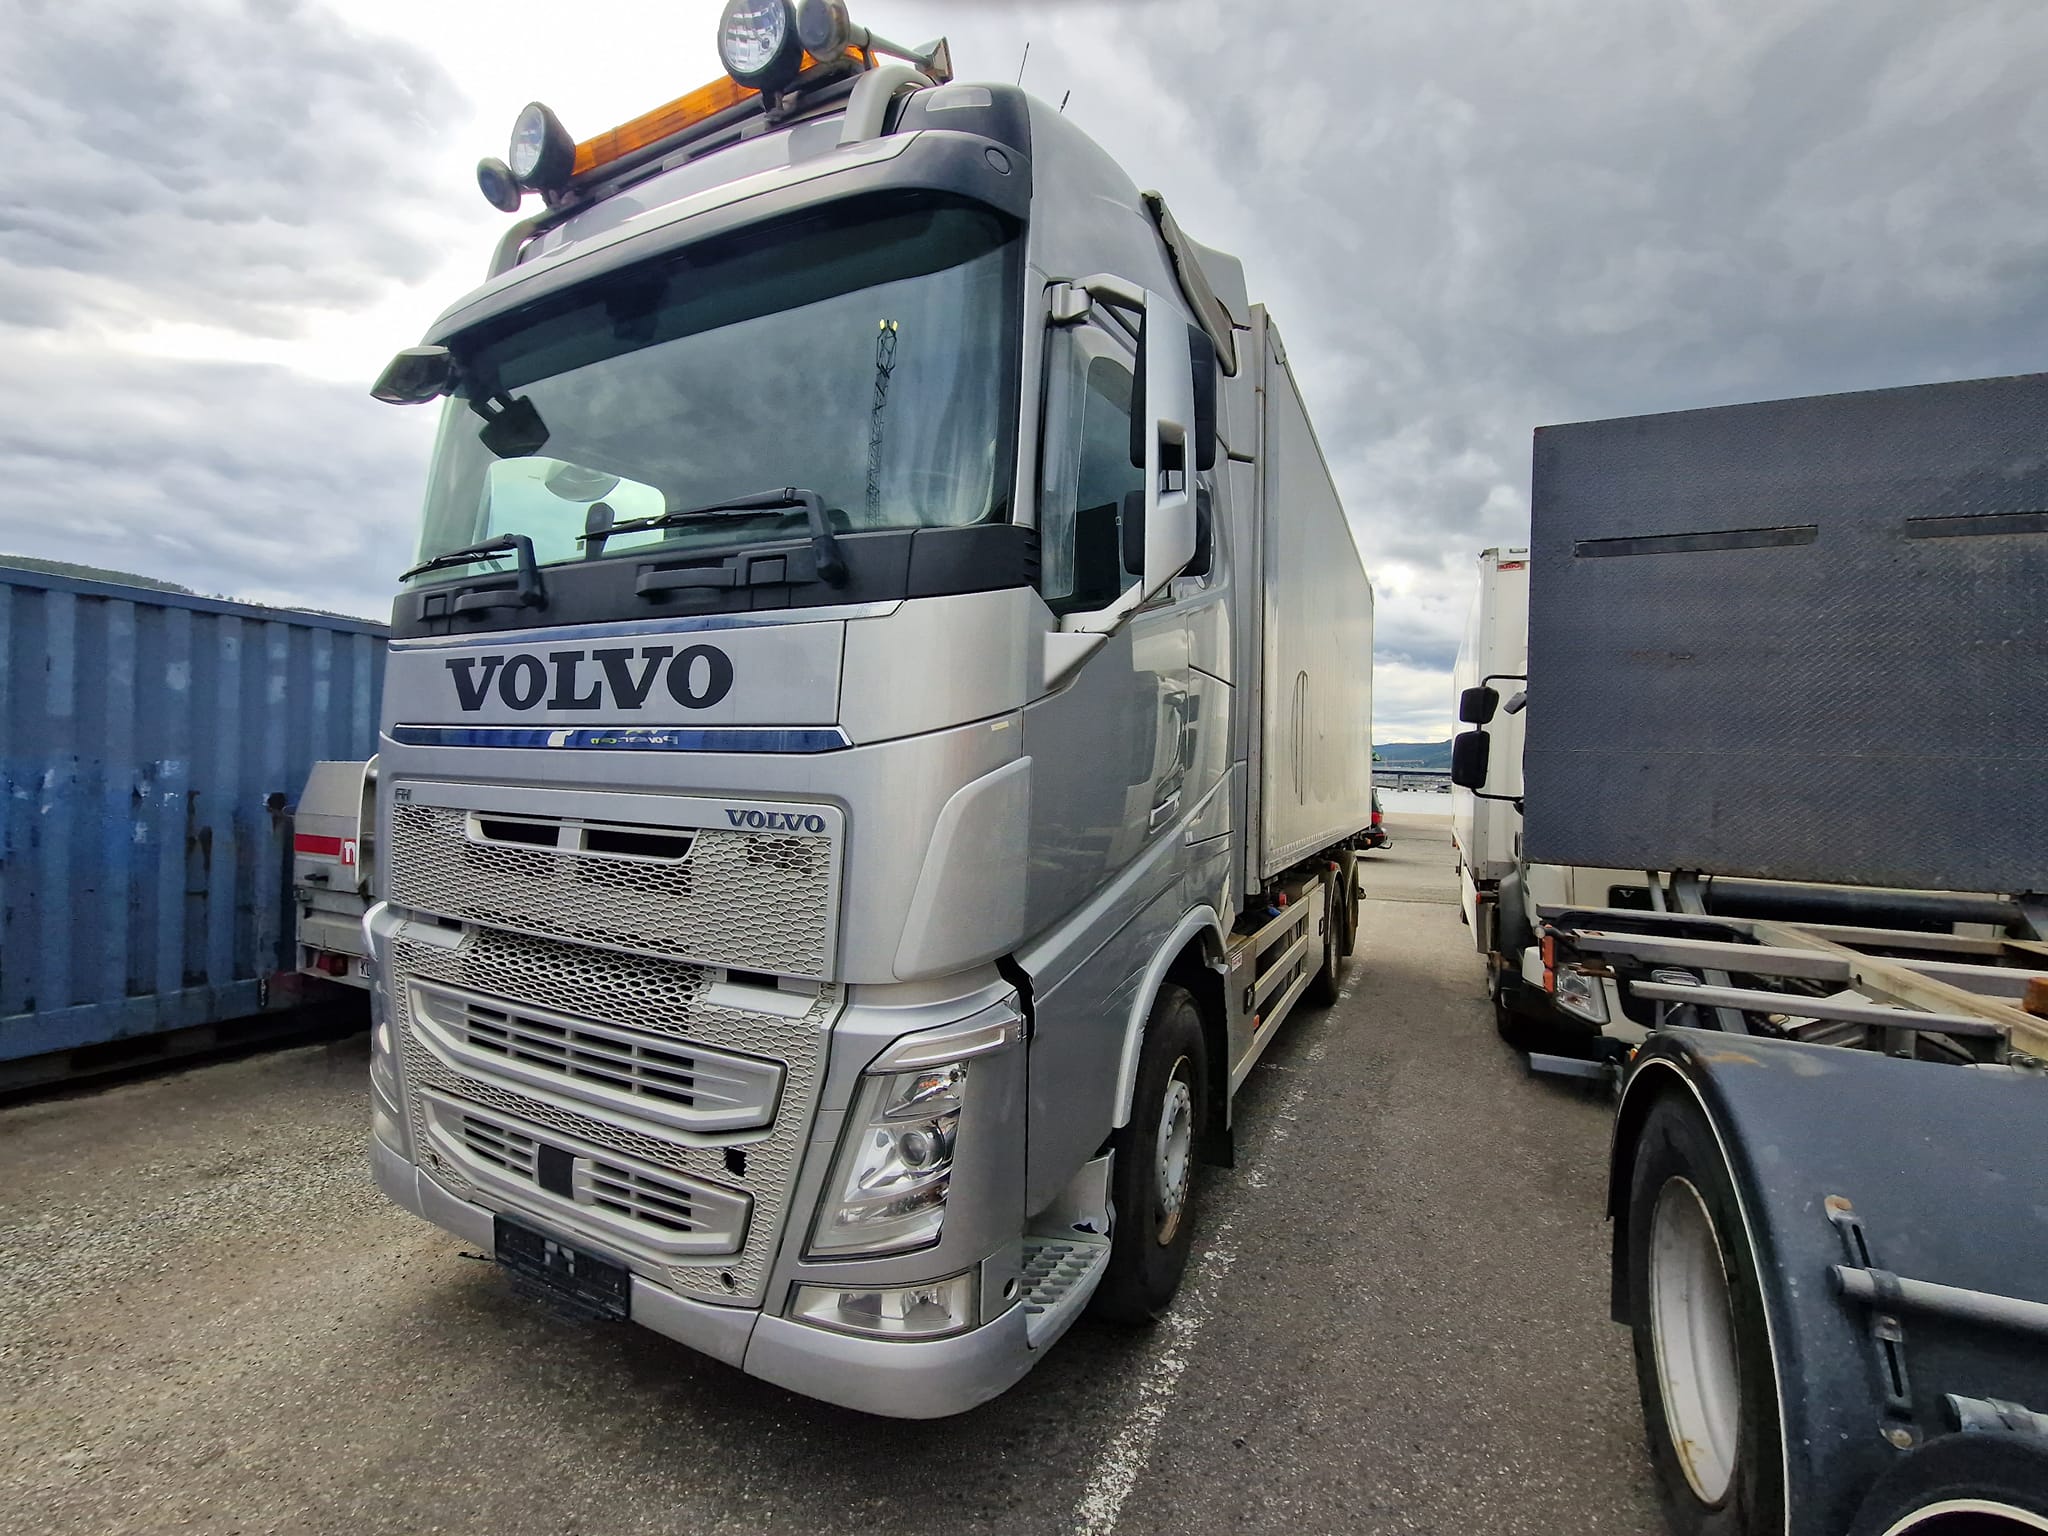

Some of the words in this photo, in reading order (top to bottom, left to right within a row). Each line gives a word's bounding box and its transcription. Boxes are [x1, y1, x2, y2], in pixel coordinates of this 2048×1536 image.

[446, 644, 734, 711] VOLVO
[395, 787, 412, 801] FH
[725, 809, 826, 834] VOLVO
